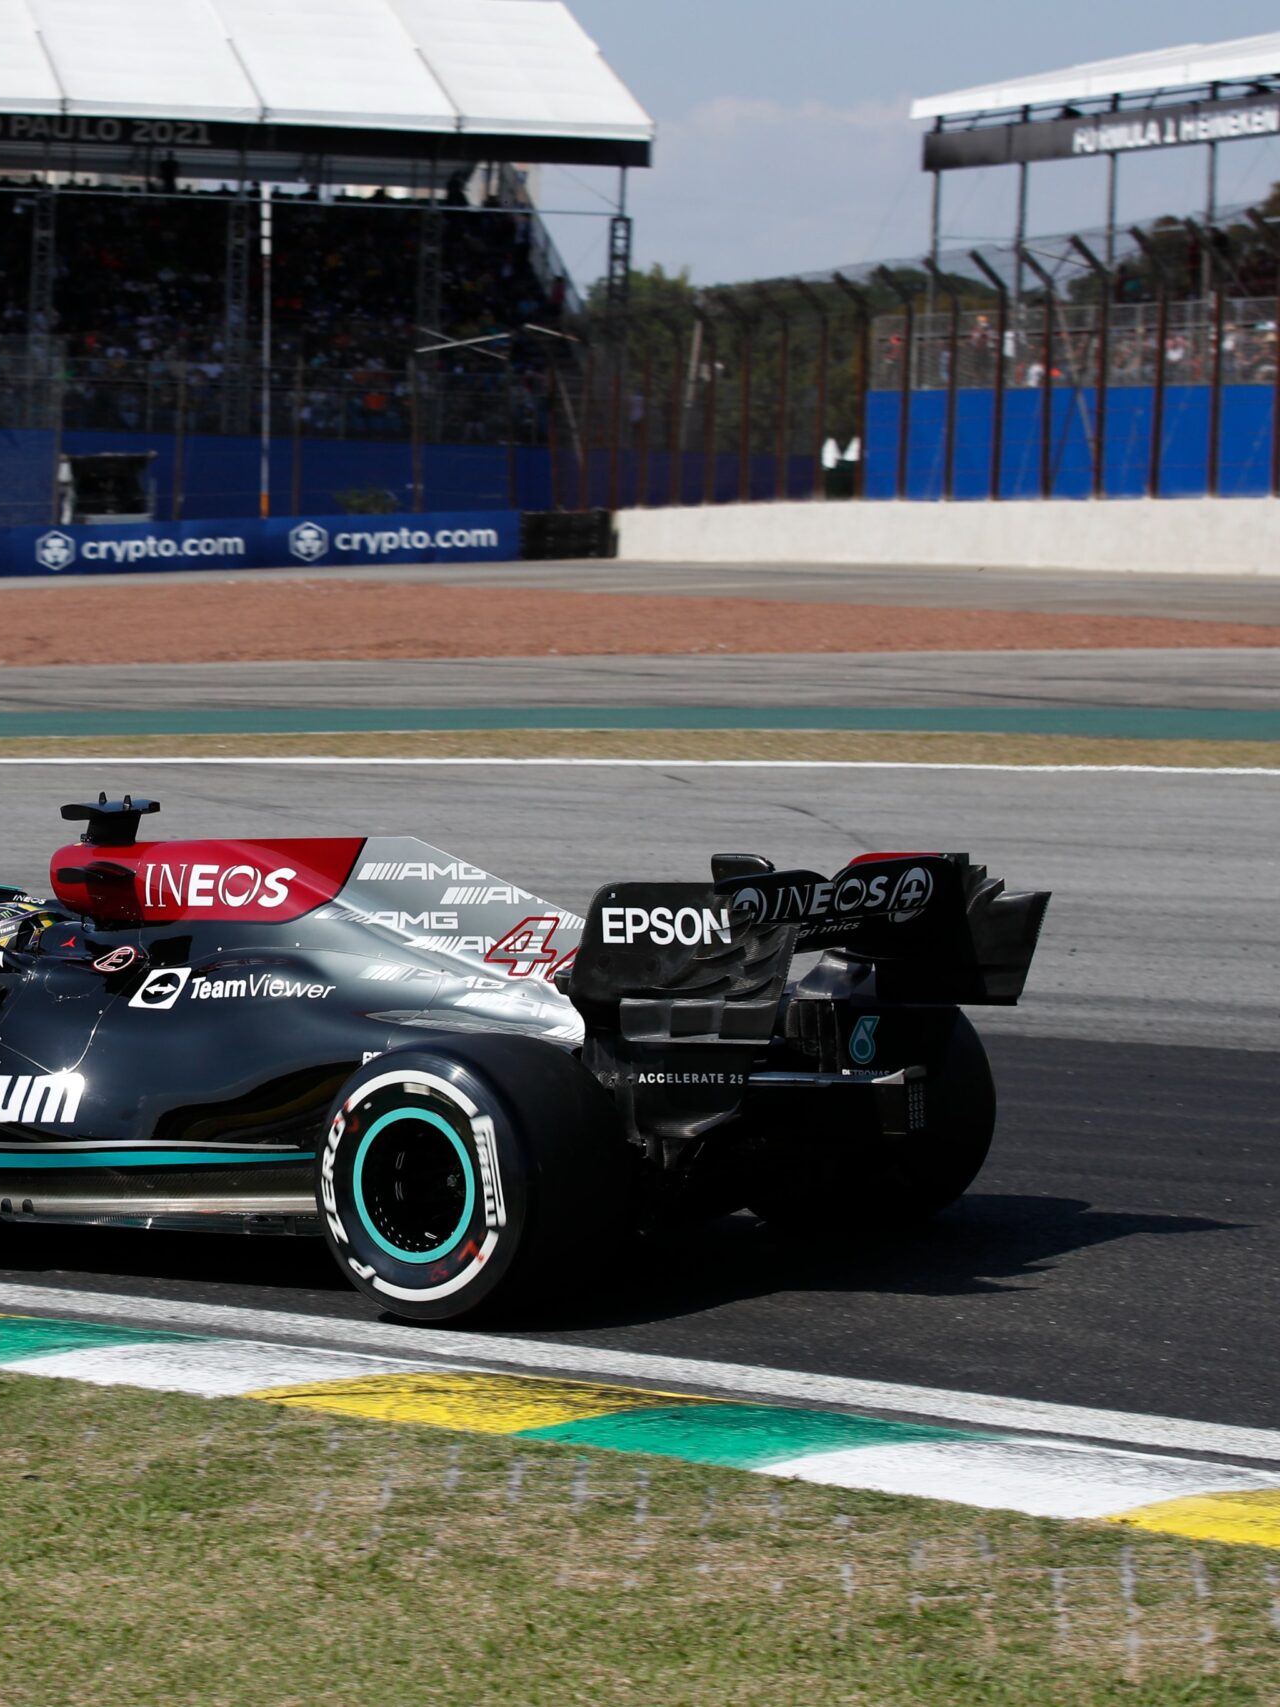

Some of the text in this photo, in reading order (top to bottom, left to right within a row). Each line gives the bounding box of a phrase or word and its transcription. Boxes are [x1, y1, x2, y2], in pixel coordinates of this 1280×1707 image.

[10, 116, 120, 141] PAULO
[131, 120, 212, 145] 2021
[81, 534, 246, 563] crypto.com
[335, 526, 498, 555] crypto.com
[144, 863, 297, 908] INEOS
[397, 862, 487, 881] AMG
[12, 894, 47, 905] INEOS
[483, 886, 547, 905] AM
[769, 875, 889, 921] INEOS
[368, 911, 459, 930] AMG
[601, 906, 732, 946] EPSON
[190, 972, 337, 999] TeamViewer
[638, 1072, 744, 1084] ACCELERATE 25
[470, 1114, 507, 1228] PIRELLI
[320, 1109, 377, 1280] P ZERO
